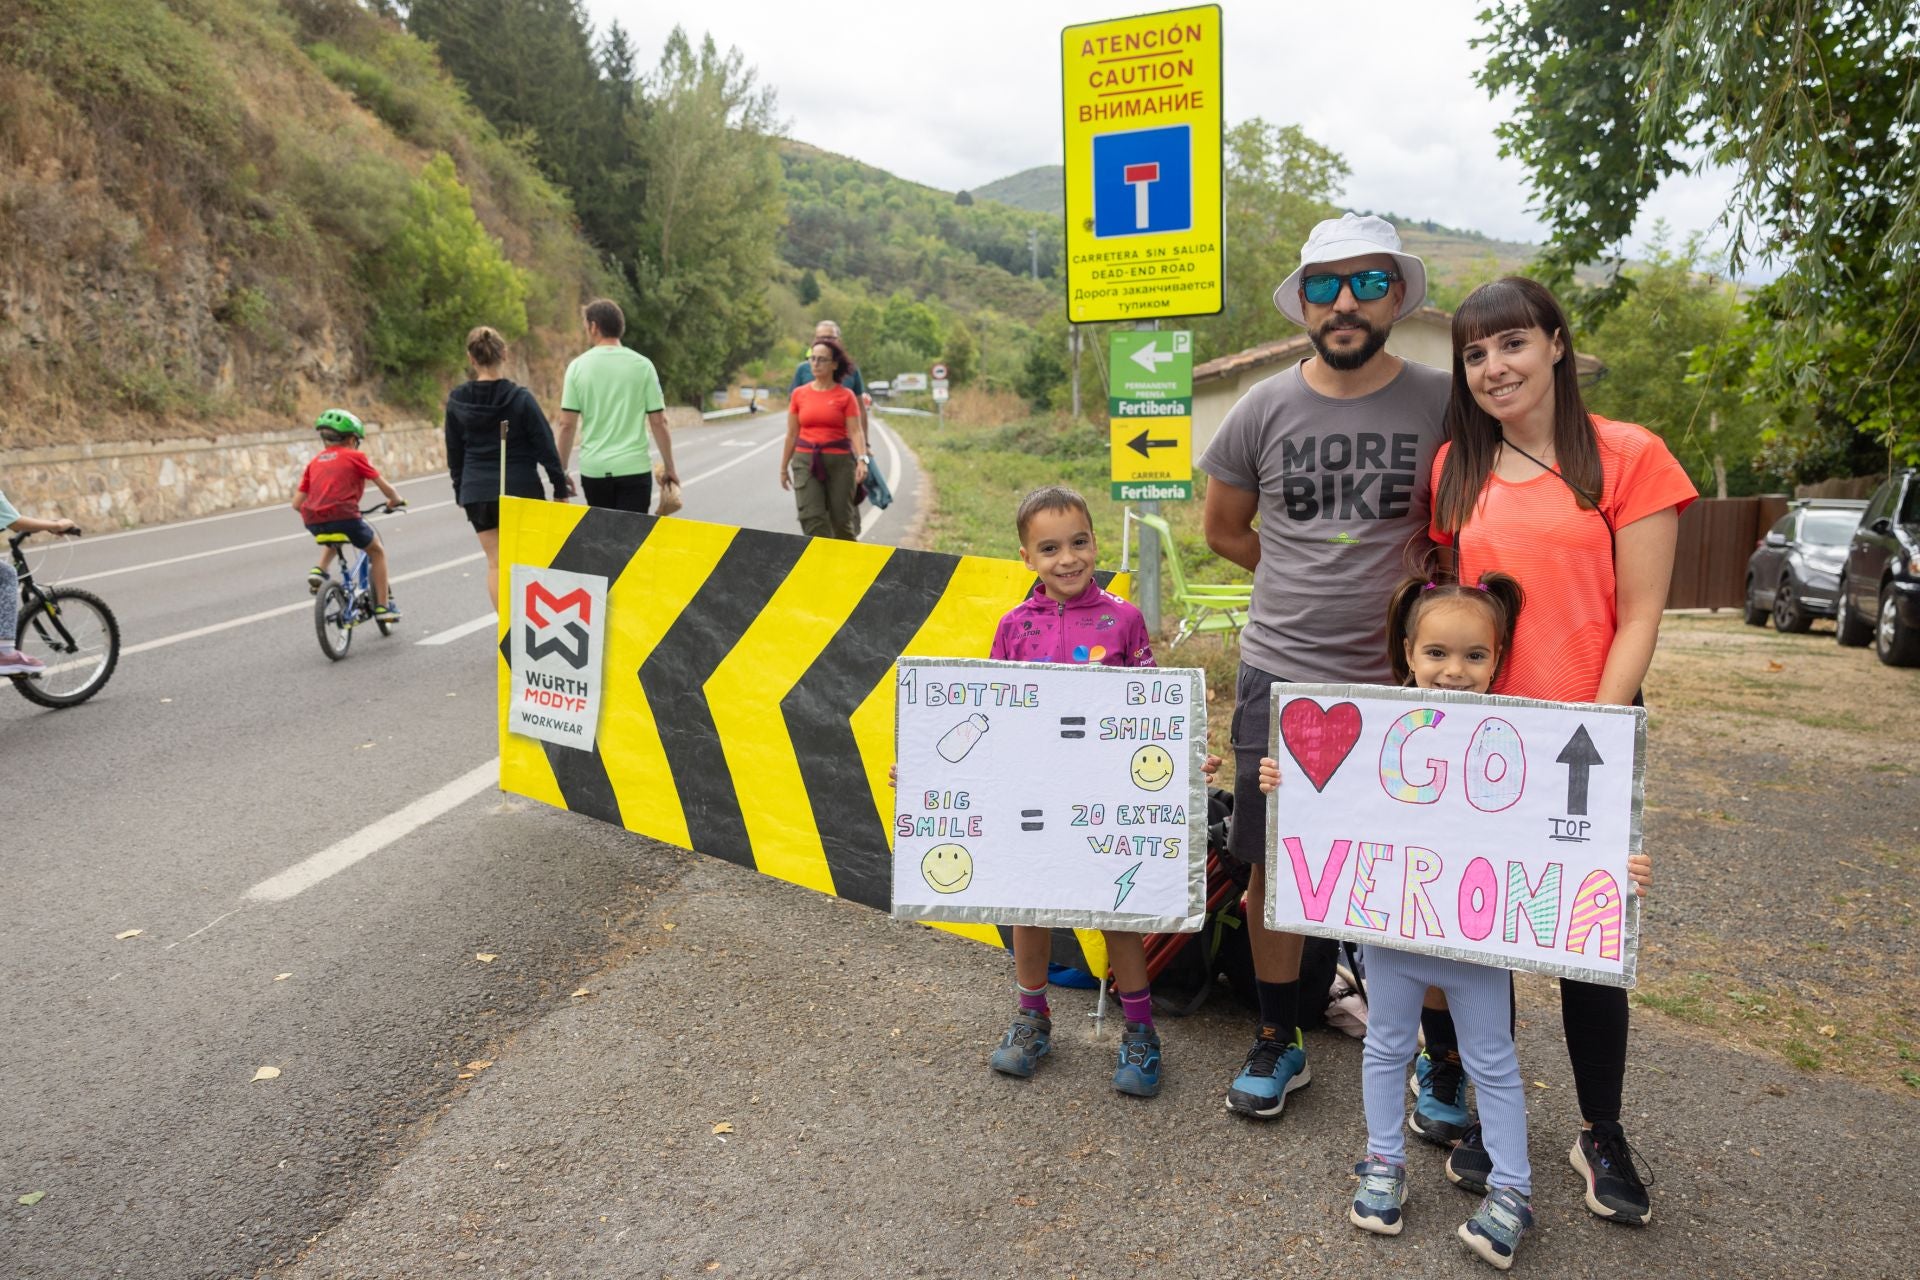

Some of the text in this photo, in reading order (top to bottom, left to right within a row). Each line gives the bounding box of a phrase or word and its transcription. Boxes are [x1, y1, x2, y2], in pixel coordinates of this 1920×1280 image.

[1081, 24, 1202, 57] ATENCIÓN
[1088, 59, 1194, 89] CAUTION
[1079, 91, 1204, 123] ВНИМАНИЕ
[1073, 243, 1215, 264] CARRETERA SIN SALIDA
[1091, 263, 1195, 280] DEAD-END ROAD
[1074, 281, 1215, 300] Дорога заканчивается
[1118, 300, 1170, 312] тупиком
[1118, 401, 1185, 415] Fertiberia
[1283, 432, 1419, 473] MORE
[1131, 471, 1171, 480] CARRERA
[1121, 485, 1185, 499] Fertiberia
[1282, 473, 1415, 521] BIKE
[901, 668, 1039, 708] 1 BOTTLE
[1126, 681, 1184, 705] BIG
[524, 688, 587, 713] MODYF
[521, 711, 583, 736] WORKWEAR
[1099, 716, 1184, 741] SMILE
[1378, 707, 1527, 813] GO
[924, 790, 970, 810] BIG
[896, 813, 983, 837] SMILE
[1071, 803, 1186, 826] 20 EXTRA
[1548, 817, 1591, 838] TOP
[1086, 834, 1182, 859] WATTS
[1282, 836, 1622, 961] VERONA
